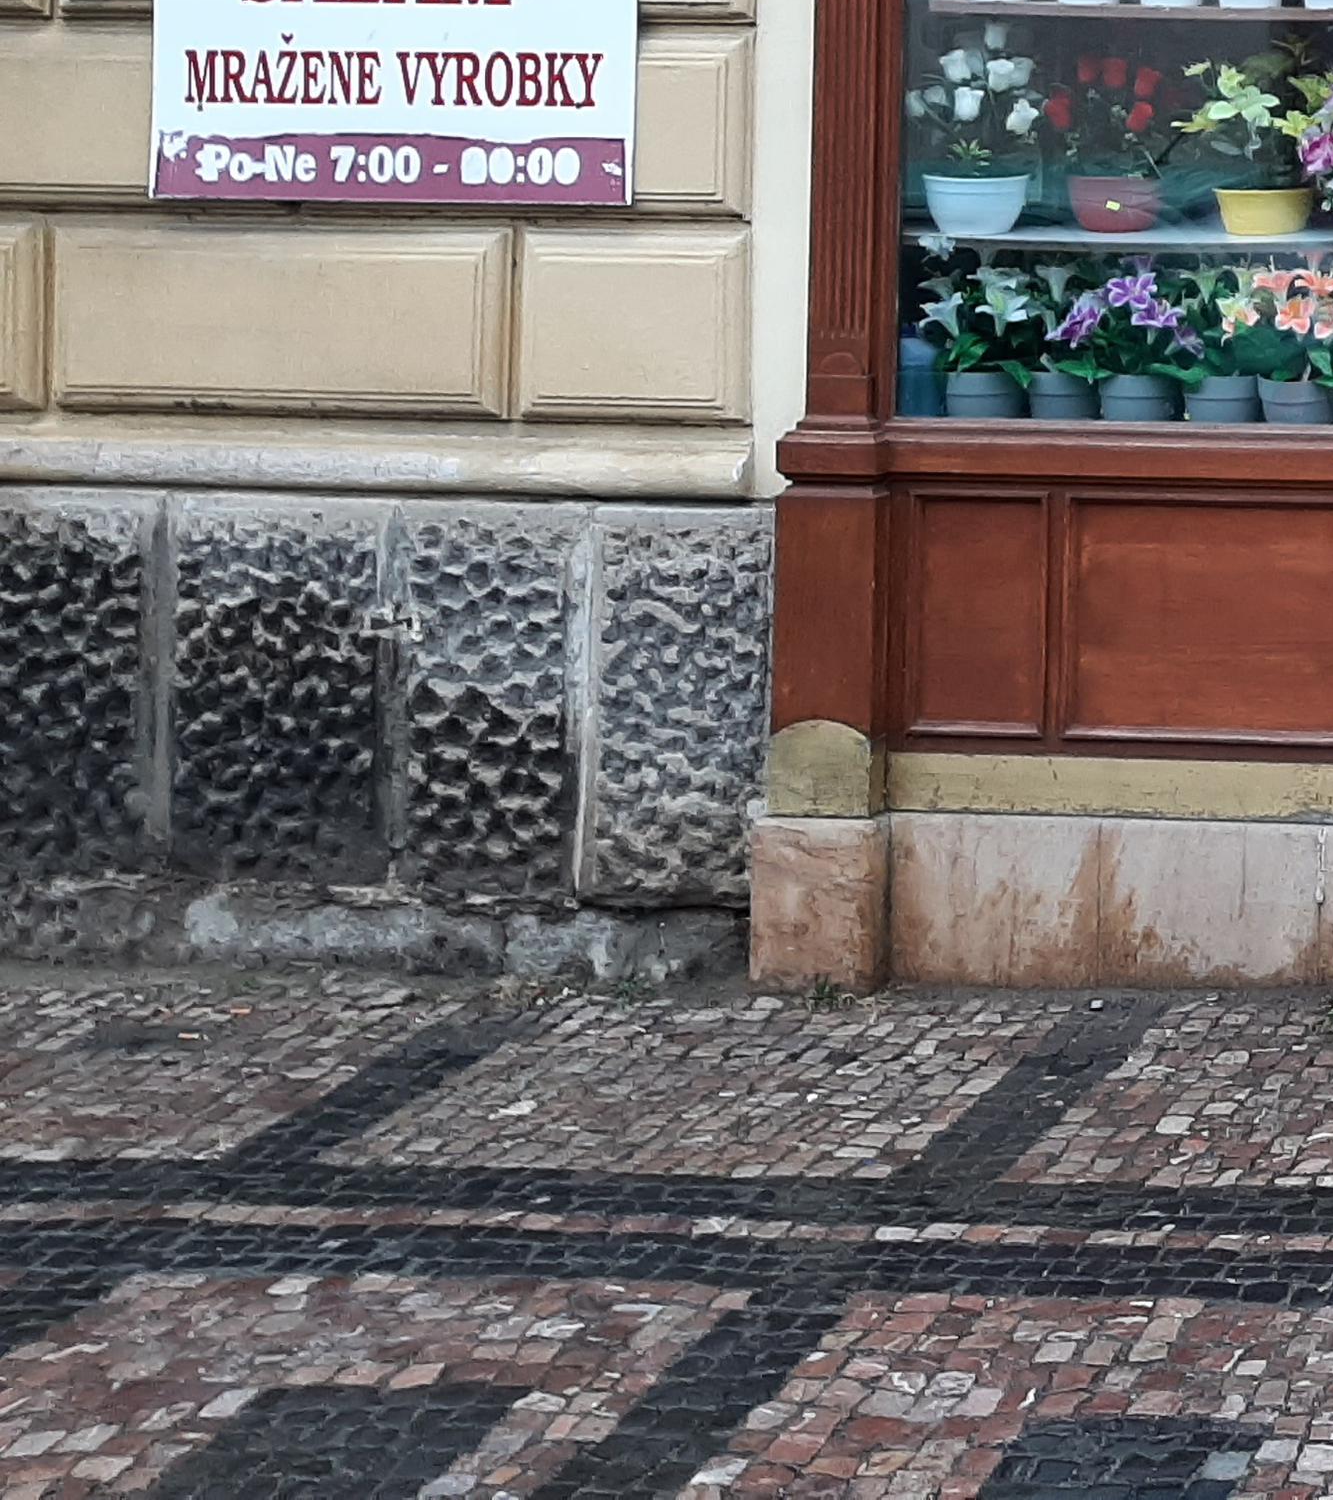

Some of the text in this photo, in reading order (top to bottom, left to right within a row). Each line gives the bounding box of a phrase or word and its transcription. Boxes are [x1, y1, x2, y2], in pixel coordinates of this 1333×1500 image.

[396, 50, 606, 109] VYROBKY
[198, 143, 318, 183] Po-Ne
[329, 144, 422, 184] 7:00
